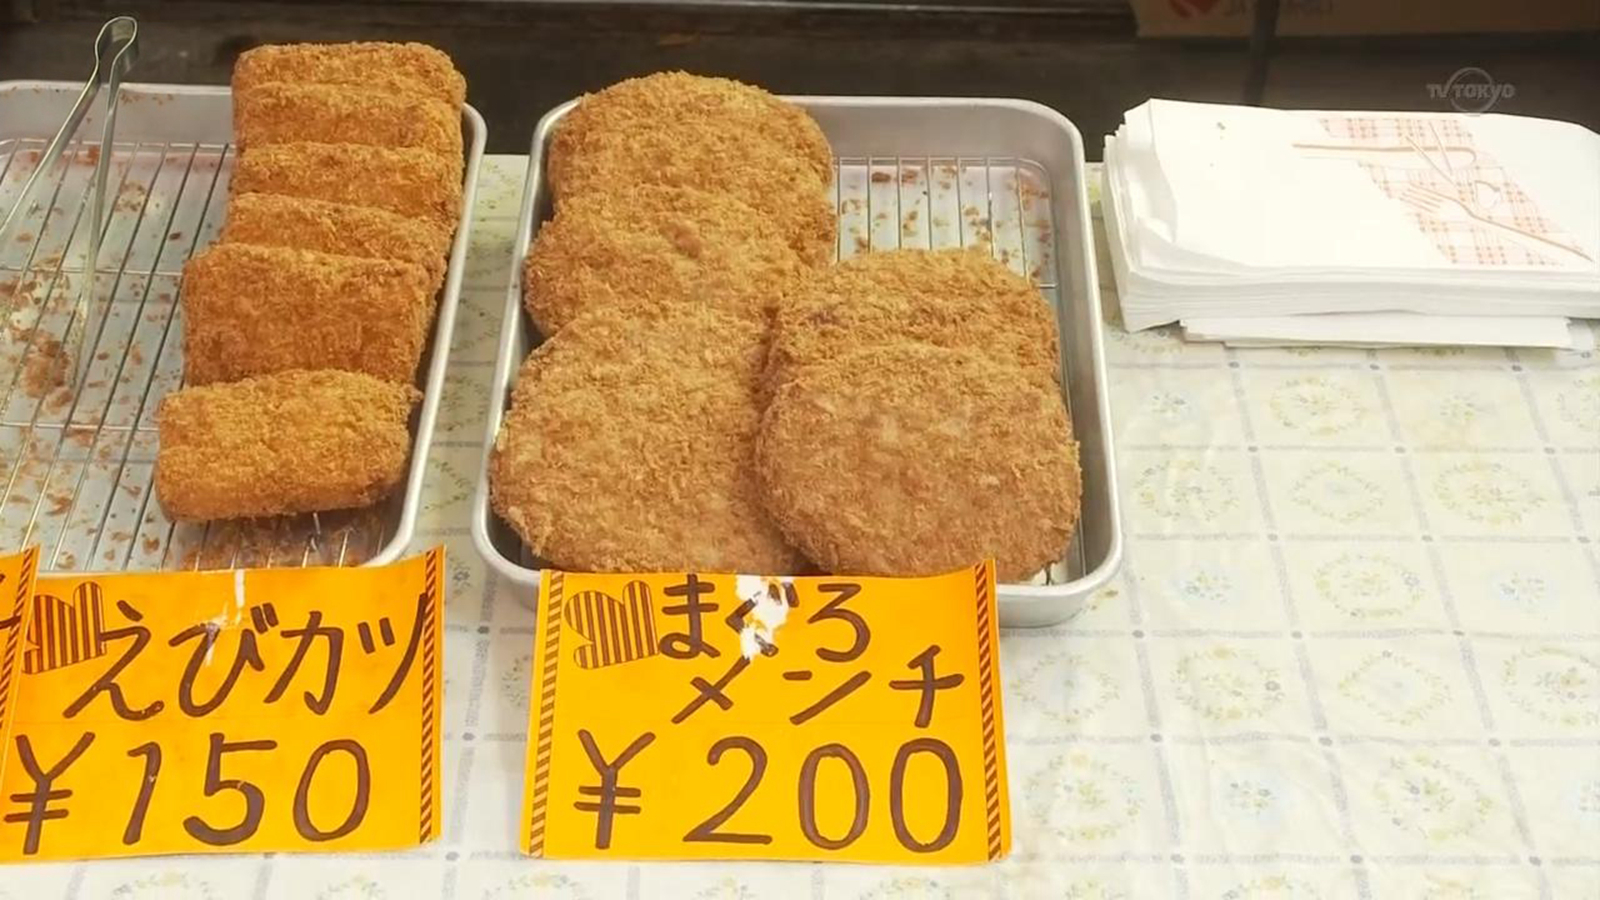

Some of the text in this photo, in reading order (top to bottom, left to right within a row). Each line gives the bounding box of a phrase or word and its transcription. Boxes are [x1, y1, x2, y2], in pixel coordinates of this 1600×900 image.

[63, 593, 429, 720] えびカツ
[658, 573, 872, 662] まぐろ
[671, 645, 965, 728] メンチ
[4, 732, 371, 855] ¥150
[574, 729, 963, 853] ¥200
